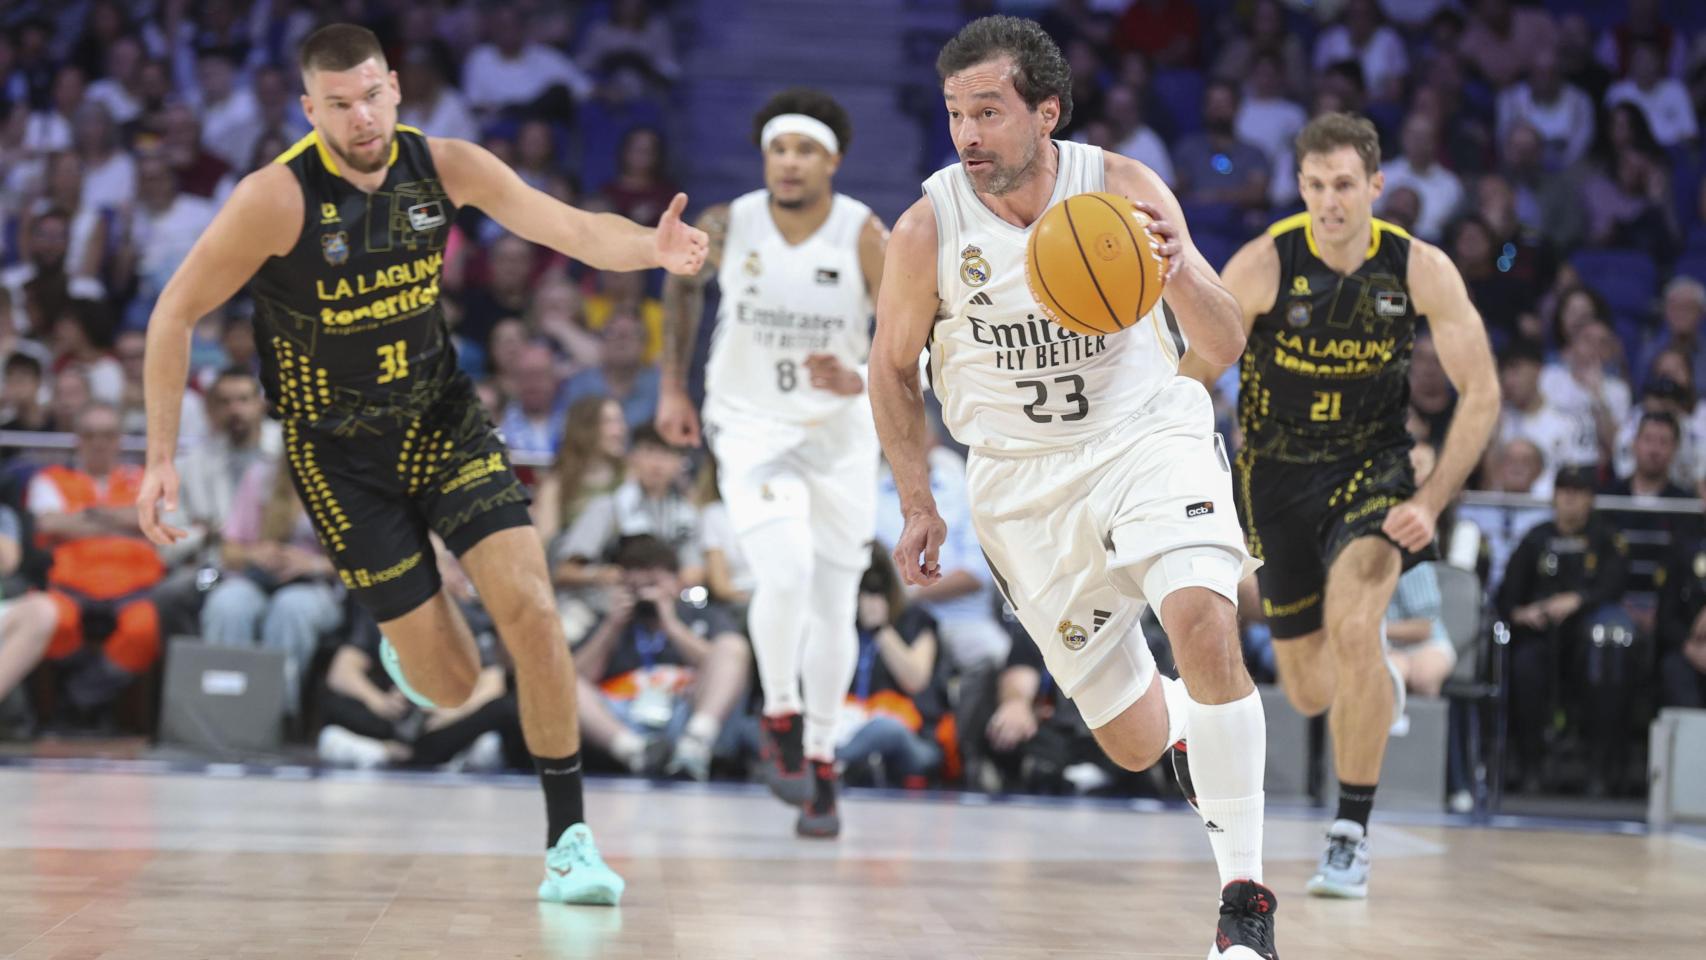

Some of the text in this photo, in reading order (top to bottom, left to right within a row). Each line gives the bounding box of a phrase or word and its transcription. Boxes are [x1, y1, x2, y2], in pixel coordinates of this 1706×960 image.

[317, 251, 443, 301] LA LAGUNA
[966, 313, 1081, 349] Emira
[376, 339, 409, 384] 31
[996, 334, 1107, 371] FLY BETTER
[776, 358, 799, 394] 8
[1015, 373, 1090, 424] 23
[1310, 390, 1342, 422] 21
[1188, 506, 1209, 517] acb
